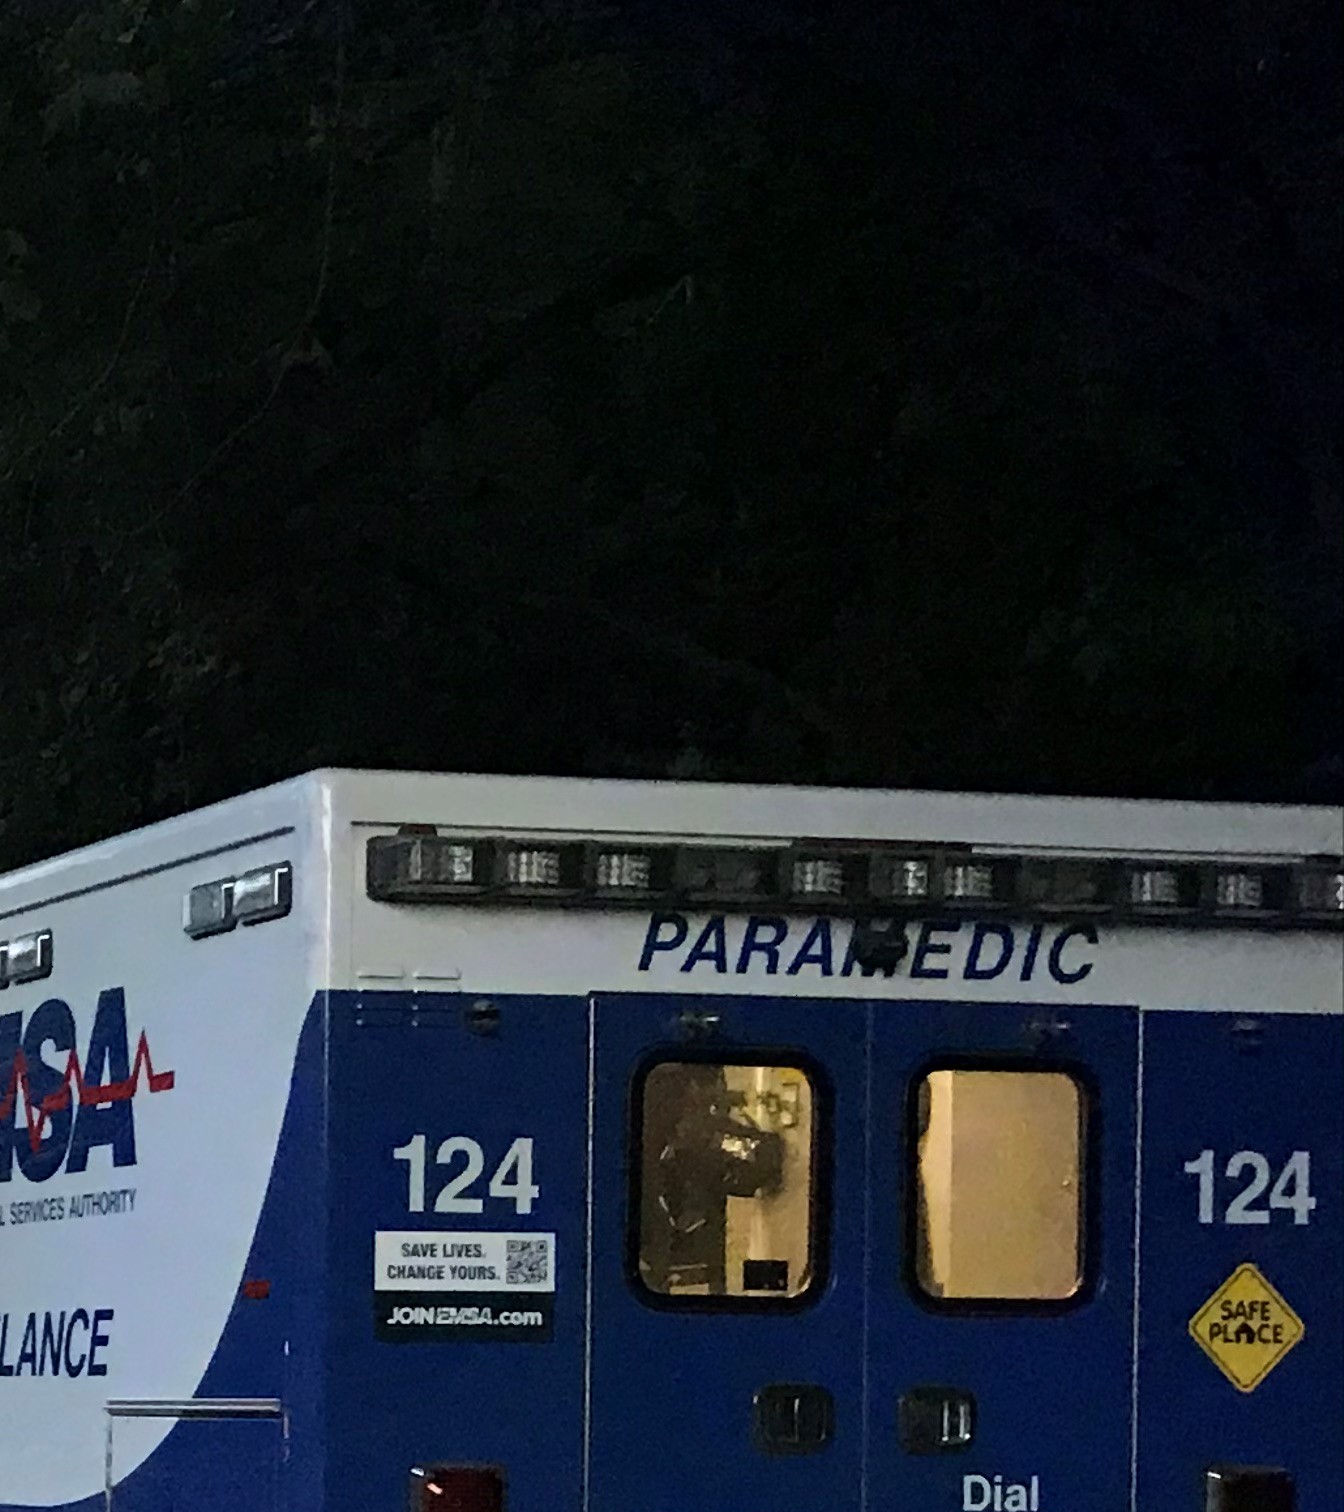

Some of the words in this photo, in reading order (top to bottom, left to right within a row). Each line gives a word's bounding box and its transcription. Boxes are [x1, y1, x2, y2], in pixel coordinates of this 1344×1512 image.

[393, 1134, 540, 1215] 124
[1184, 1149, 1317, 1225] 124
[10, 1197, 65, 1225] SERVICES
[69, 1188, 138, 1219] AUTHORITY
[401, 1243, 438, 1258] SAVE
[443, 1243, 487, 1259] LIVES.
[386, 1264, 445, 1280] CHANGE
[449, 1265, 501, 1281] YOURS.
[1220, 1300, 1271, 1322] SAFE
[963, 1475, 1039, 1512] Dial
